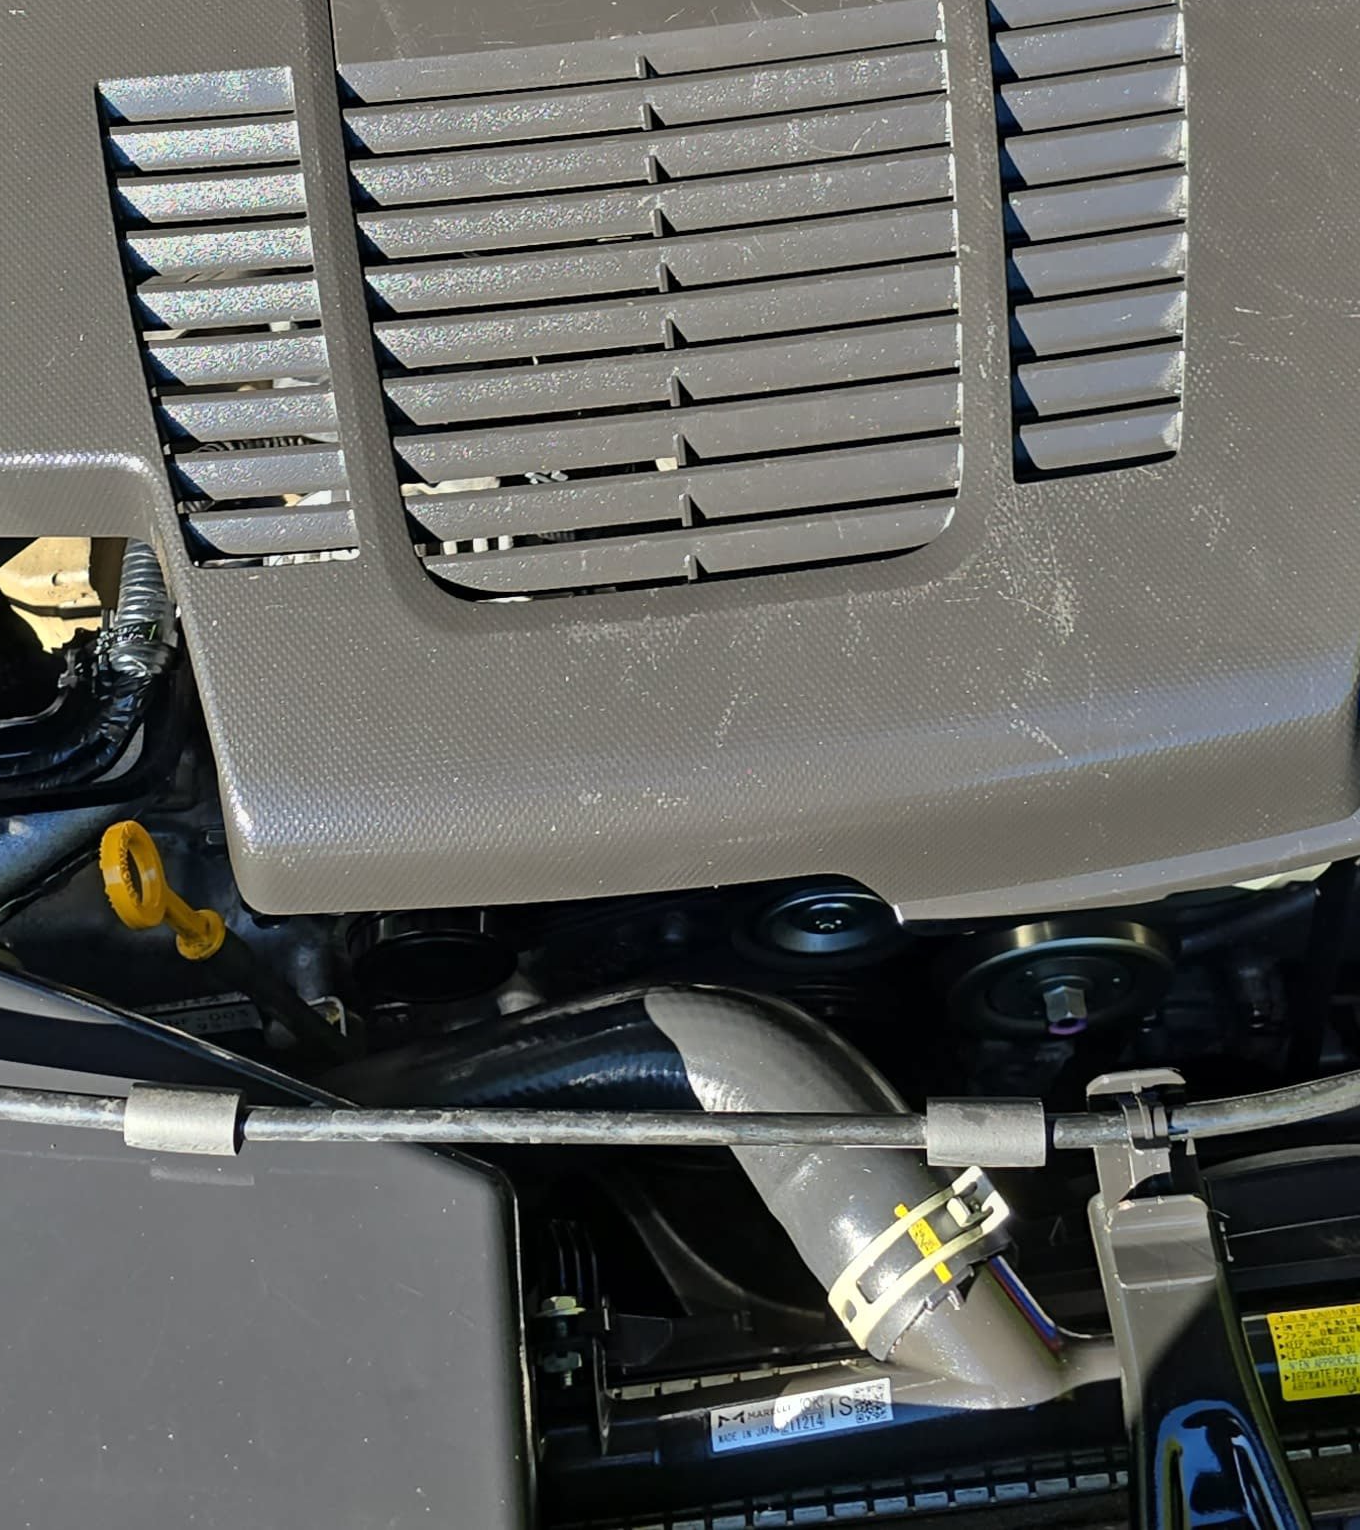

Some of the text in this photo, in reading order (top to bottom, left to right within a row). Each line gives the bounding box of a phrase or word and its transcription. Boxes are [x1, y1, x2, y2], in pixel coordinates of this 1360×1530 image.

[747, 1404, 791, 1420] MARELLI
[718, 1430, 738, 1444] MADE
[742, 1429, 752, 1438] IN
